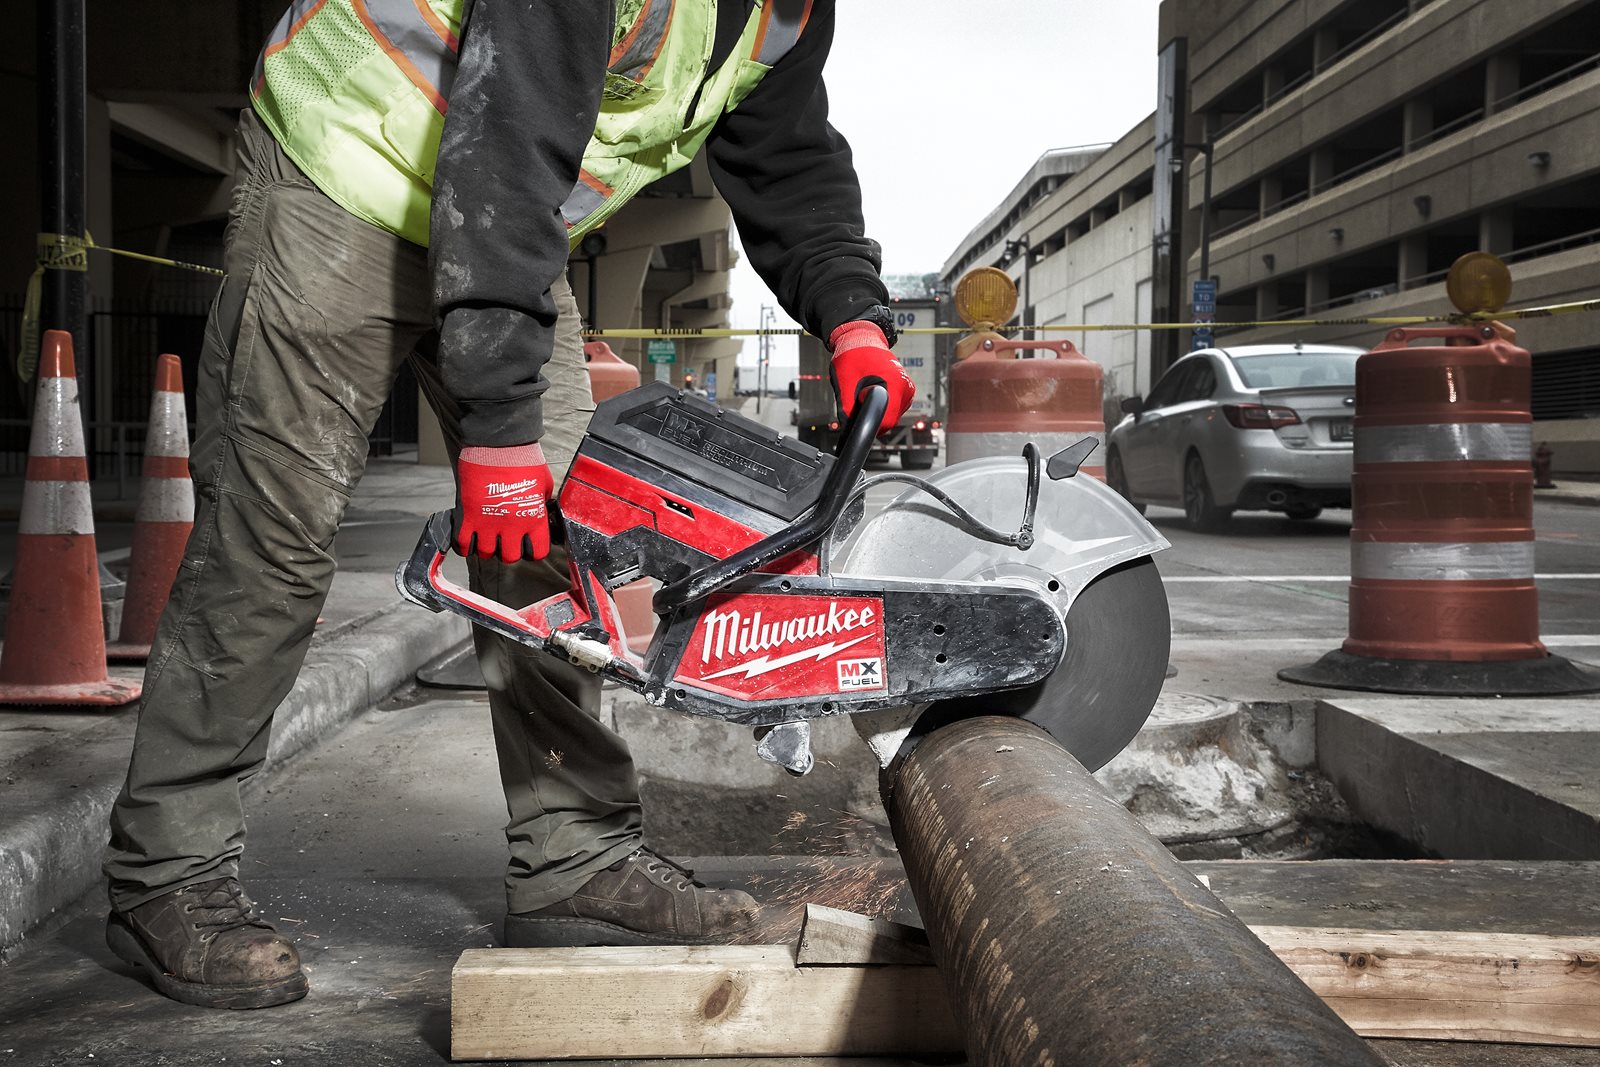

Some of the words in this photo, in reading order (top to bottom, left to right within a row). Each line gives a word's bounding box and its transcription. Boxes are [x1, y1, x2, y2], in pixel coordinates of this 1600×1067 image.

[669, 412, 705, 439] MX
[484, 479, 537, 495] Milwaukee
[701, 602, 876, 665] Milwaukee
[840, 661, 878, 677] MX
[841, 677, 880, 687] FUEL
